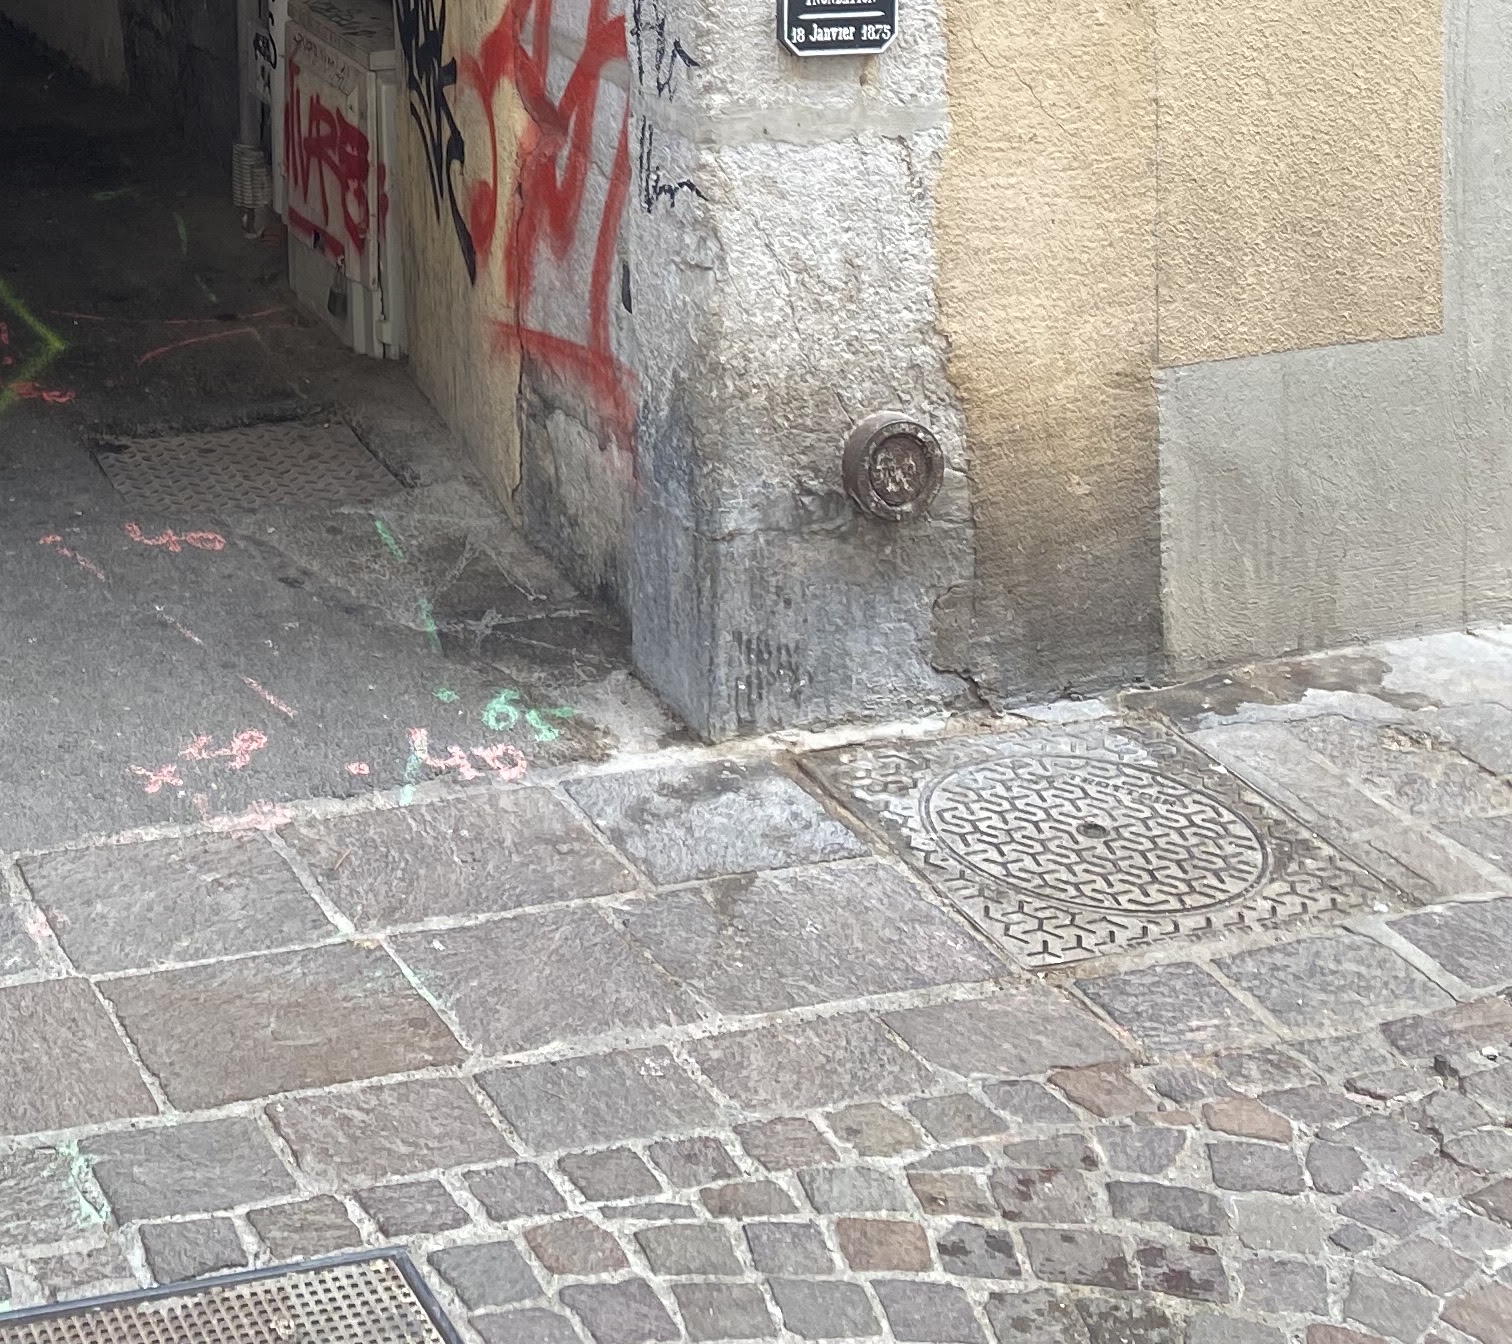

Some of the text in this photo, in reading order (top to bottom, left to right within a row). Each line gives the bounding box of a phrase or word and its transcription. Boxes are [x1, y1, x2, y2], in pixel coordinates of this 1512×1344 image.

[790, 23, 891, 44] 18 Janvier 1875
